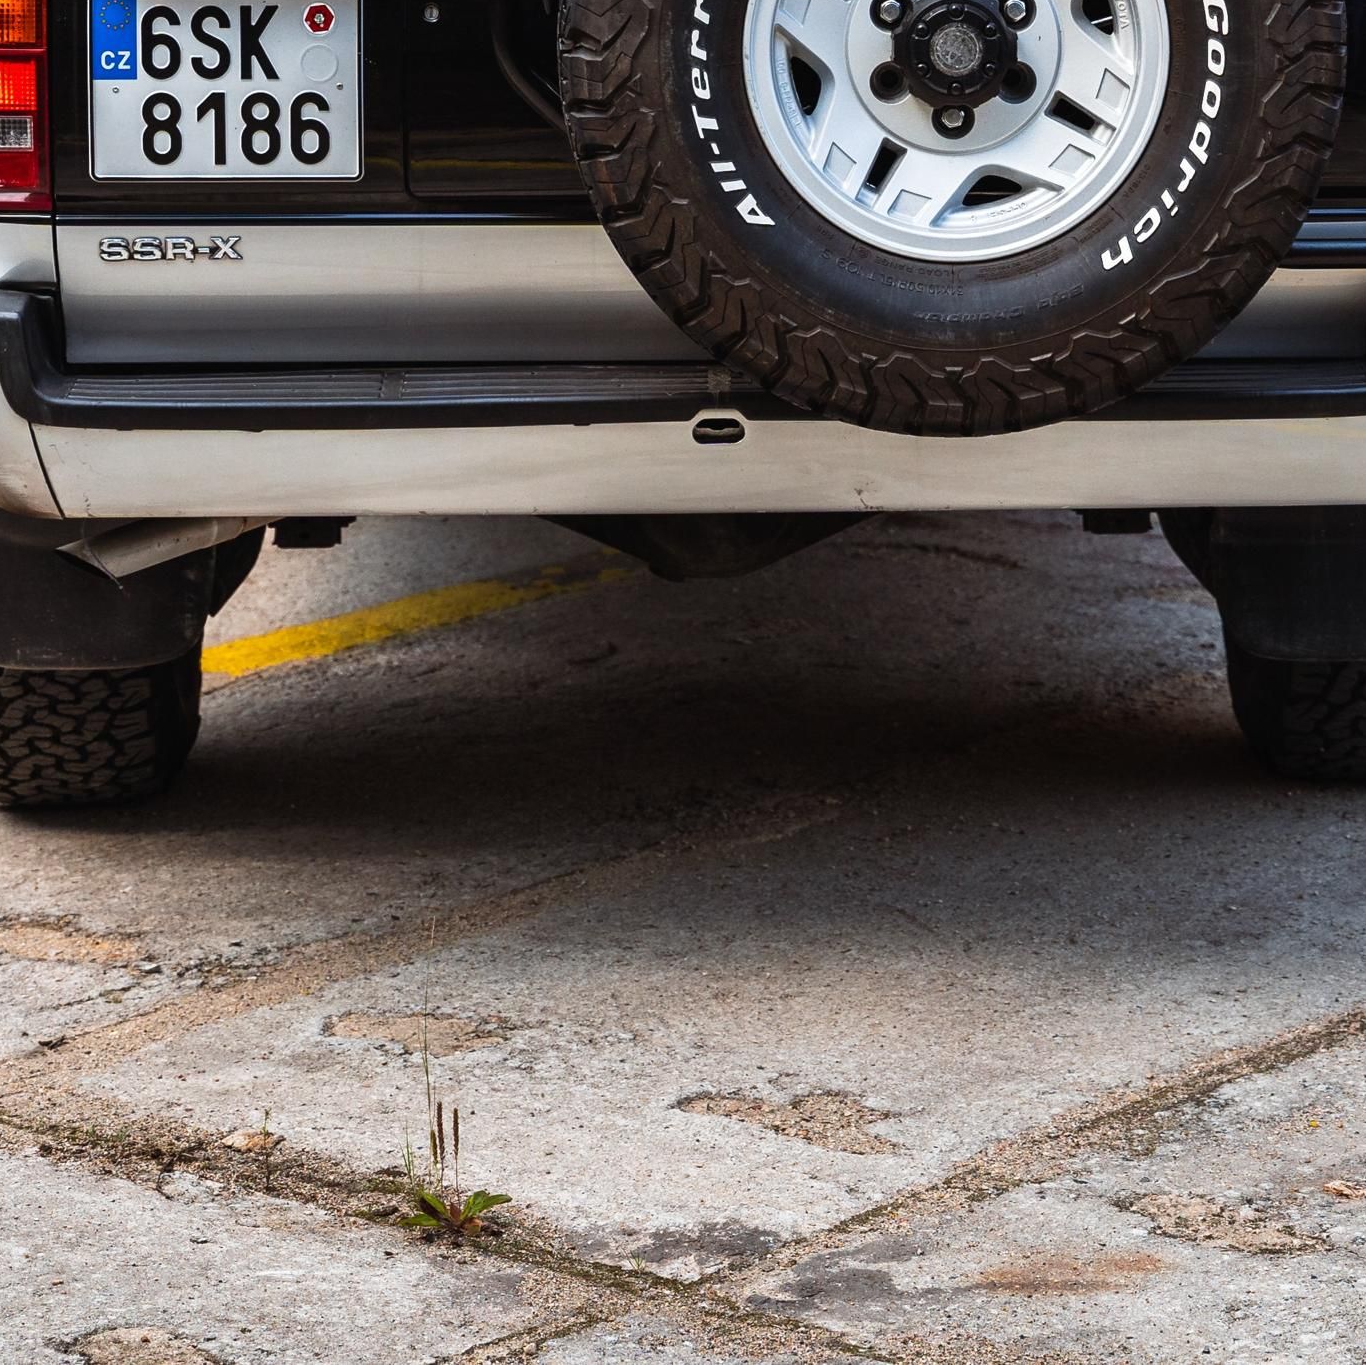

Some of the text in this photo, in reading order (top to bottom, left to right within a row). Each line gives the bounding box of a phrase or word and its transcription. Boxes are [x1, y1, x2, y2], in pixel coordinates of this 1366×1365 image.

[100, 50, 131, 70] CZ
[140, 4, 280, 81] 6SK
[141, 91, 331, 166] 8186
[98, 236, 243, 261] SSR-X
